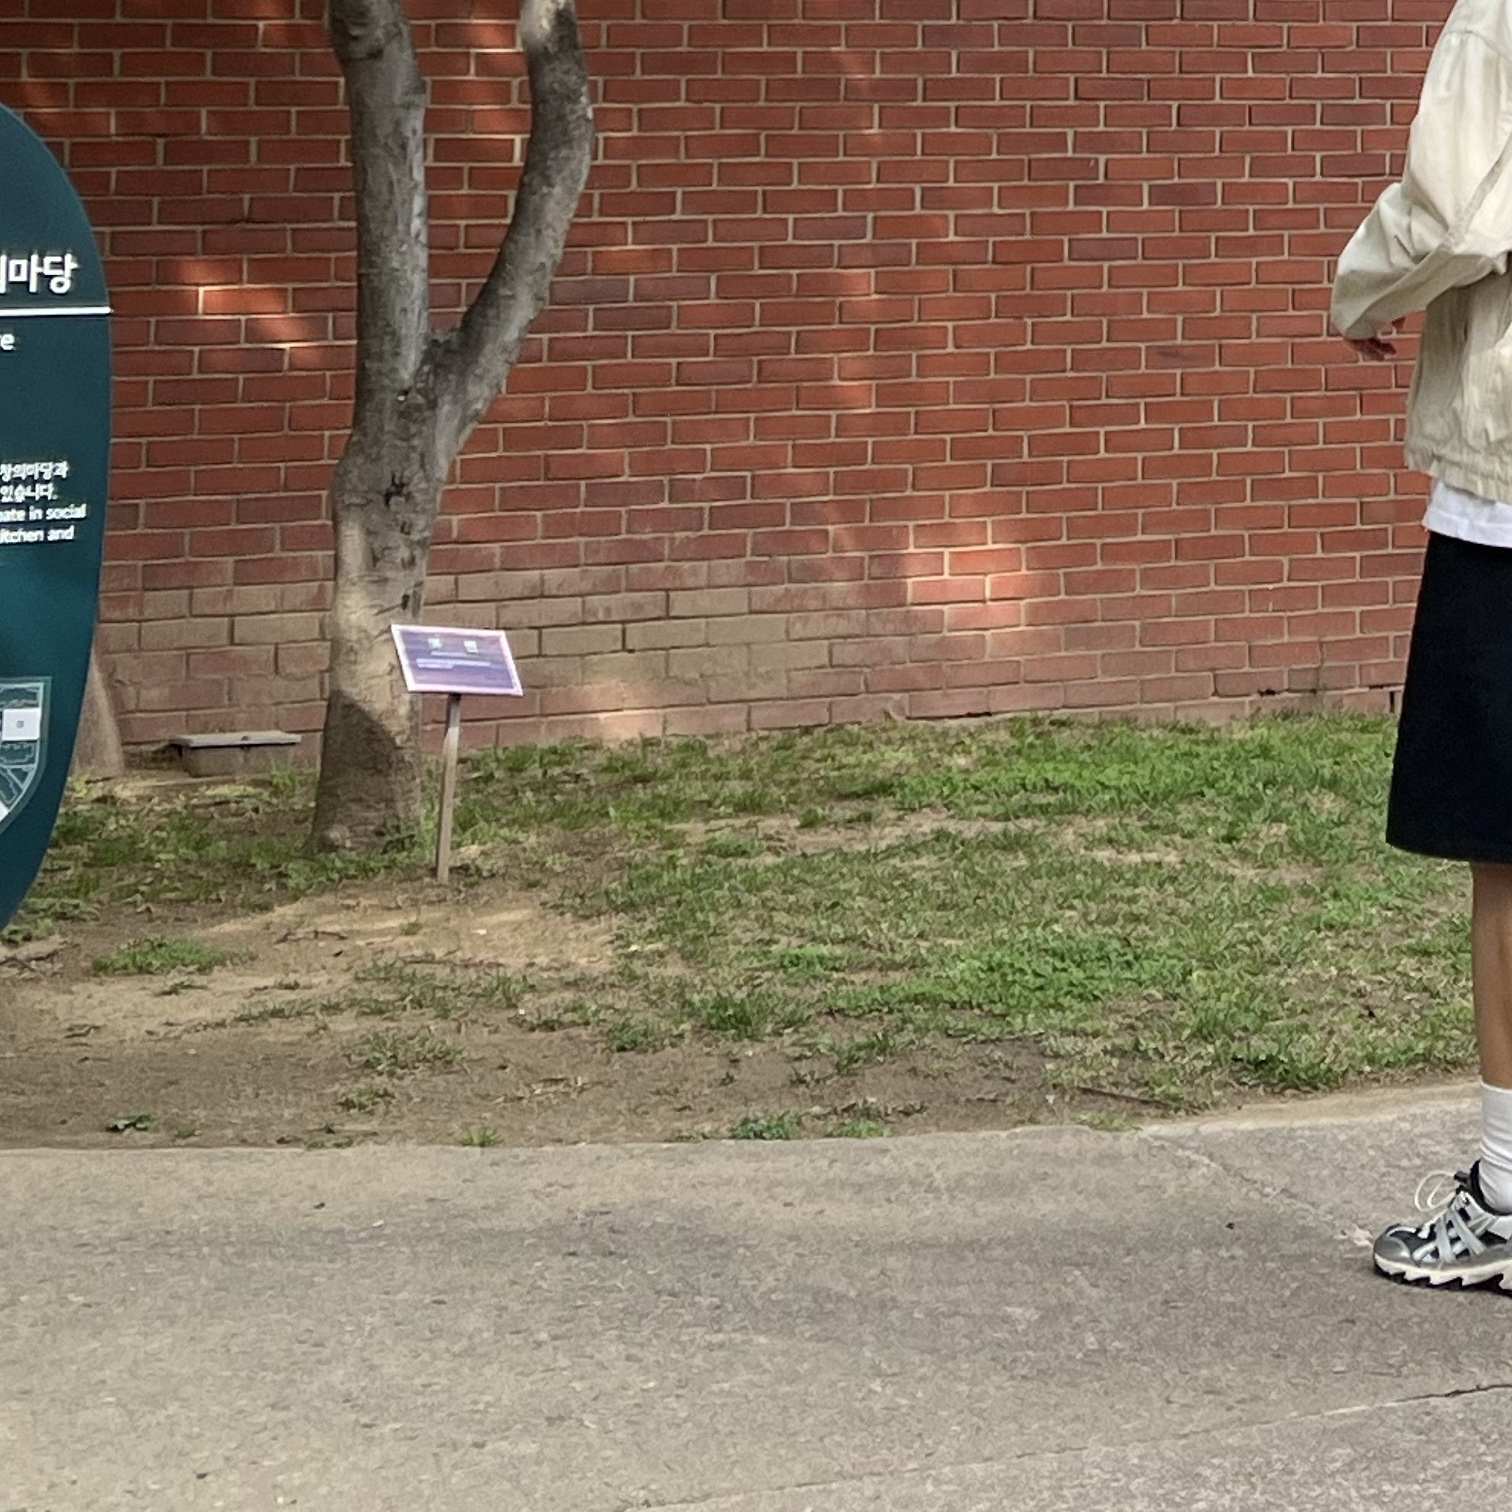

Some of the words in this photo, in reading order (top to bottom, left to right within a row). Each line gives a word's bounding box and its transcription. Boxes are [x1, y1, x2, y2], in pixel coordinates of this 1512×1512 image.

[0, 508, 26, 522] ate
[29, 505, 43, 520] in
[45, 503, 87, 520] social
[0, 528, 44, 544] itchen
[47, 525, 75, 541] and
